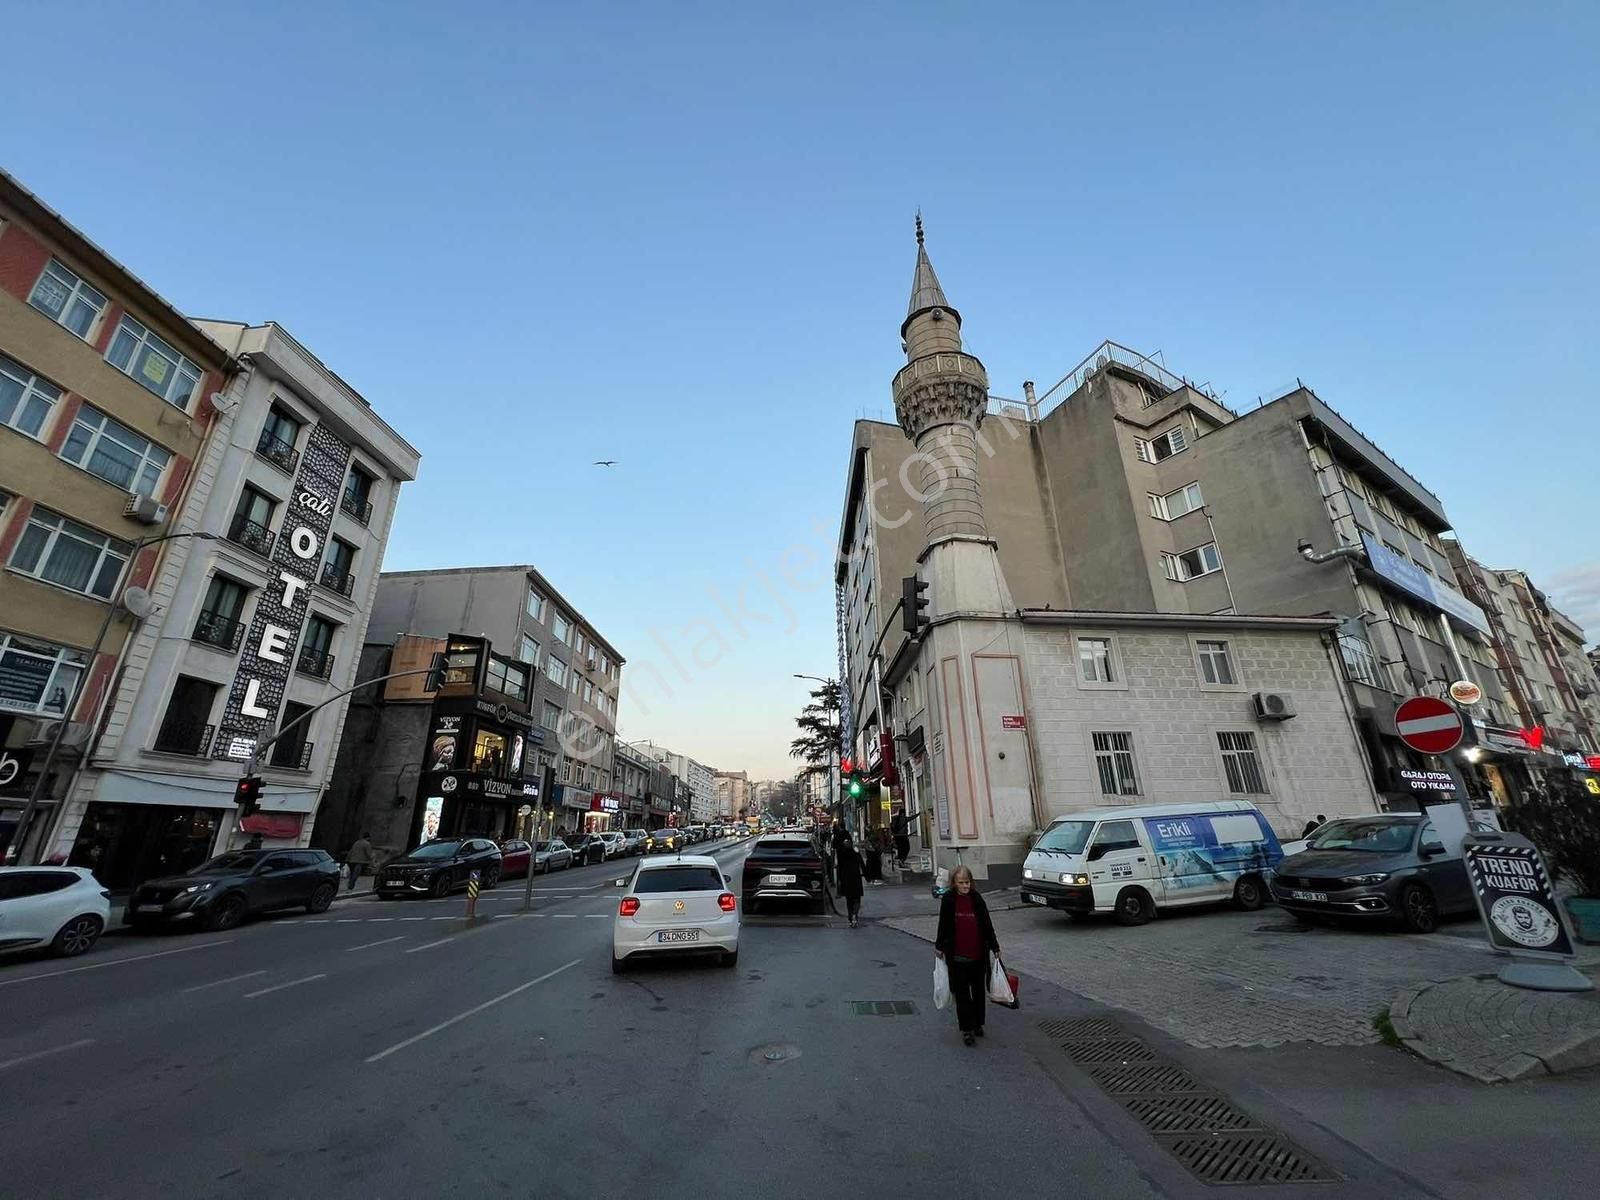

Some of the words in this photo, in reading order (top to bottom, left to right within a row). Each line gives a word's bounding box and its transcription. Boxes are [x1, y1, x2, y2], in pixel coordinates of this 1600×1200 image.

[240, 526, 318, 719] OTEL
[1401, 770, 1427, 779] GARAJ
[1427, 772, 1452, 781] OTOPA
[483, 778, 512, 794] VİZYON
[1410, 781, 1427, 789] OTO
[1427, 782, 1456, 790] YIKAMA
[1156, 822, 1192, 838] Erikli
[1477, 857, 1534, 876] TREND
[1484, 874, 1540, 891] KUAFÖR
[662, 932, 671, 941] 34
